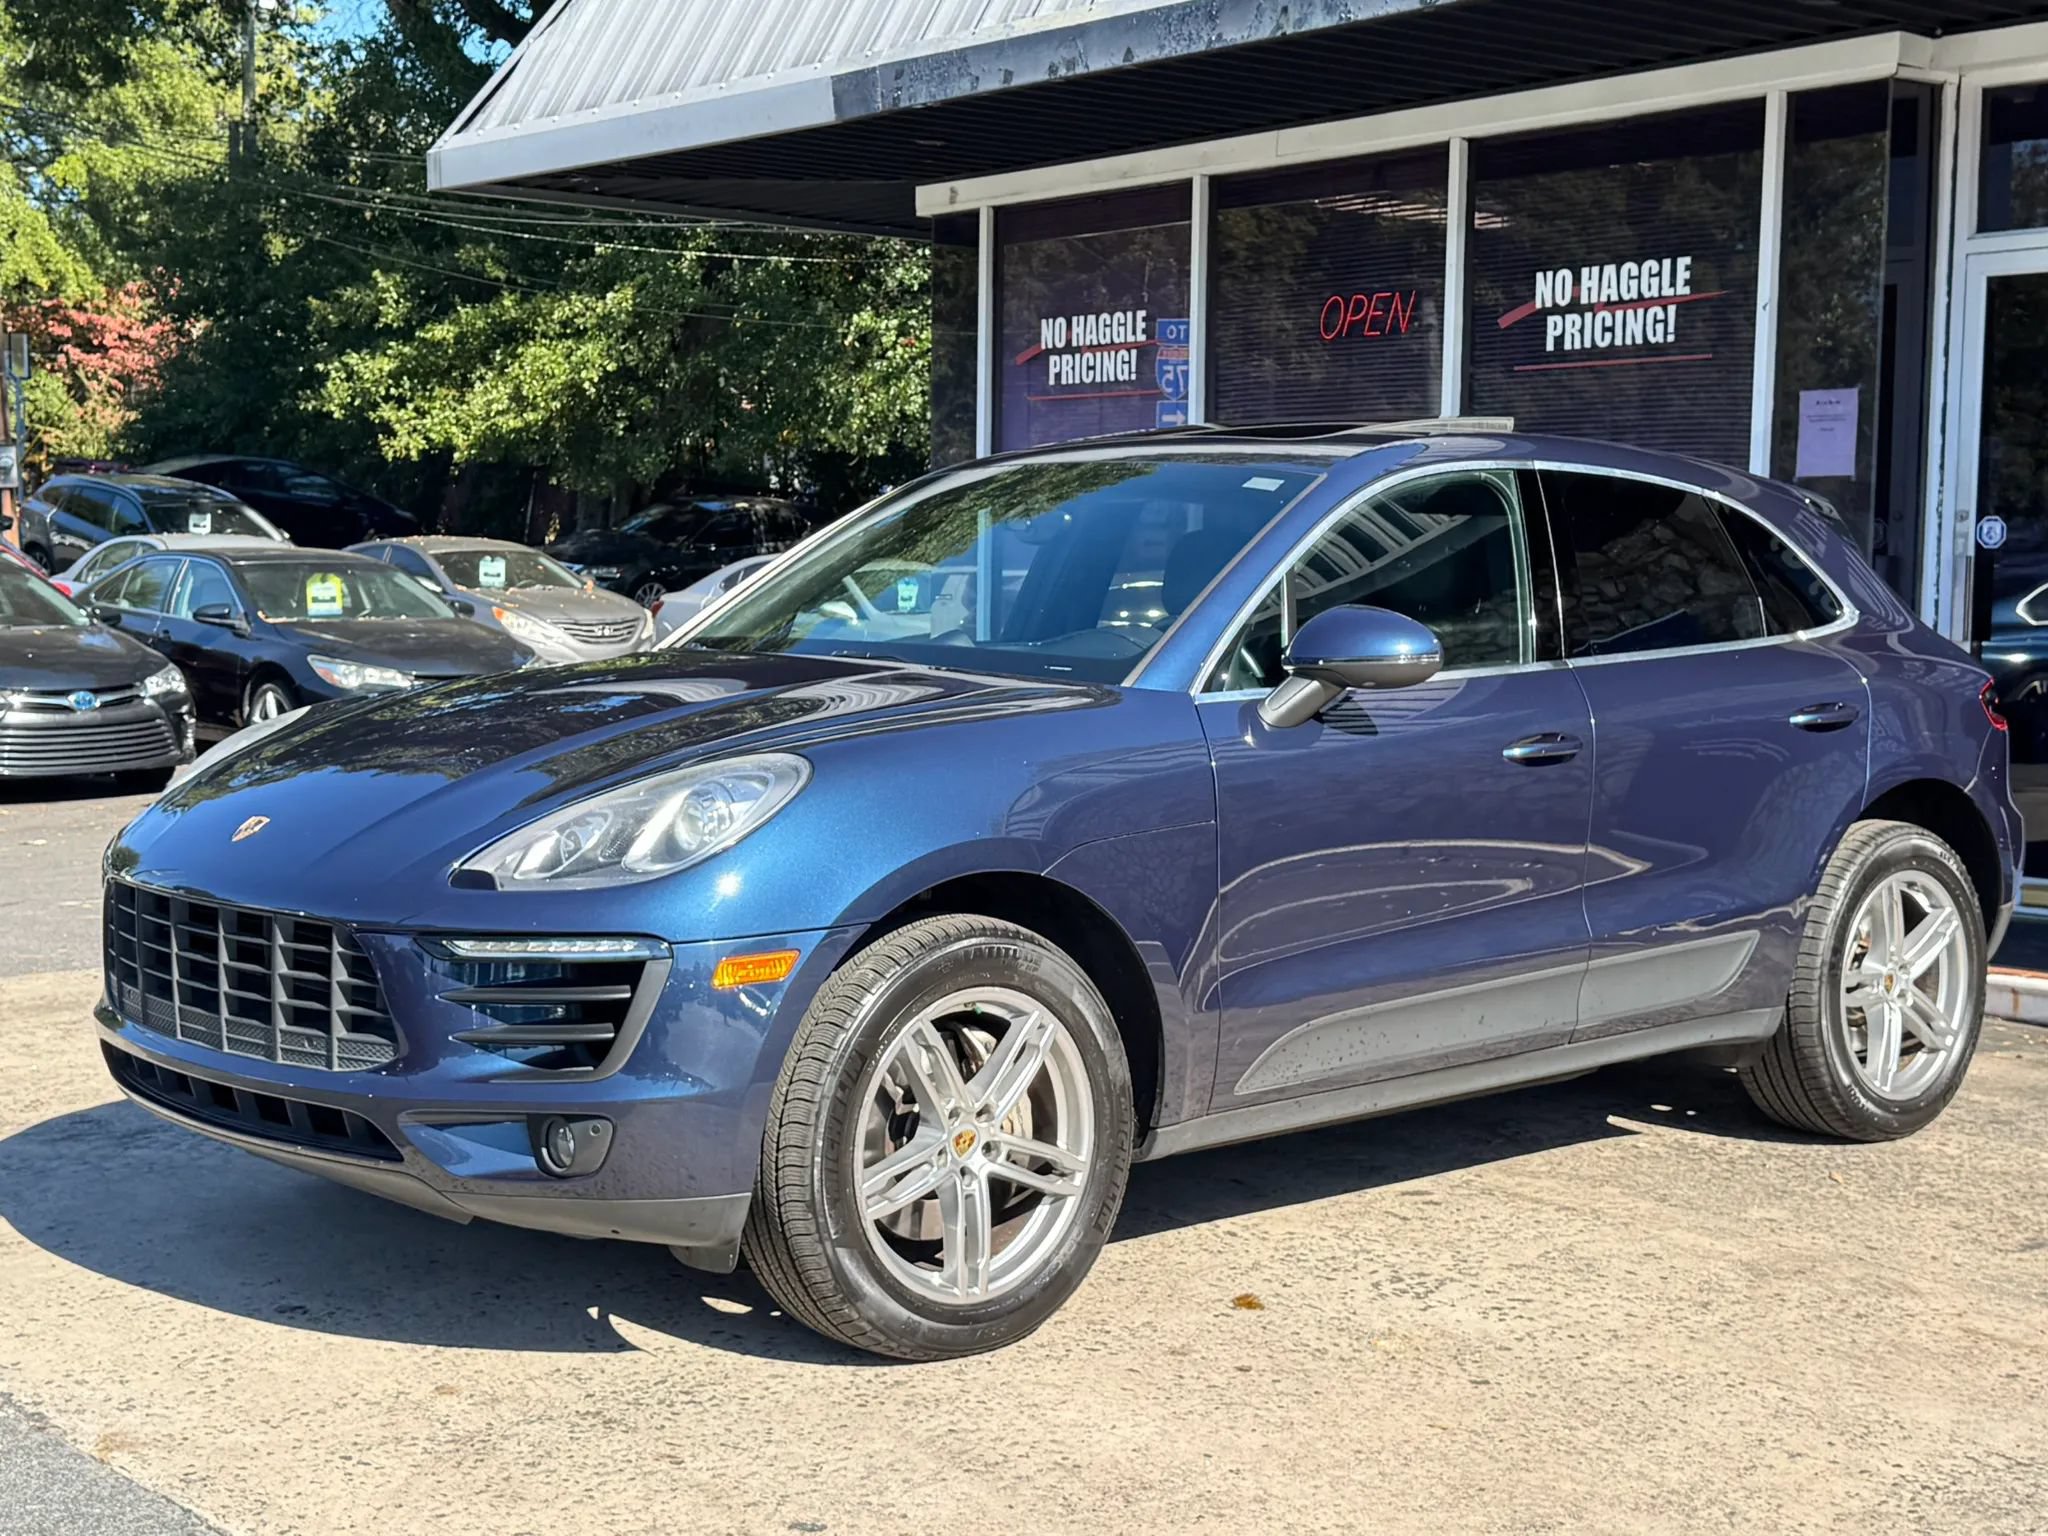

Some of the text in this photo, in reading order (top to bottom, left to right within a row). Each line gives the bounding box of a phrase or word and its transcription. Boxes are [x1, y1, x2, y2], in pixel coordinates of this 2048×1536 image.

[1535, 256, 1692, 309] NO HAGGLE
[1040, 309, 1147, 349] NO HAGGLE
[1320, 289, 1416, 340] OPEN
[1546, 304, 1677, 352] PRICING!
[1048, 348, 1138, 386] PRICING!
